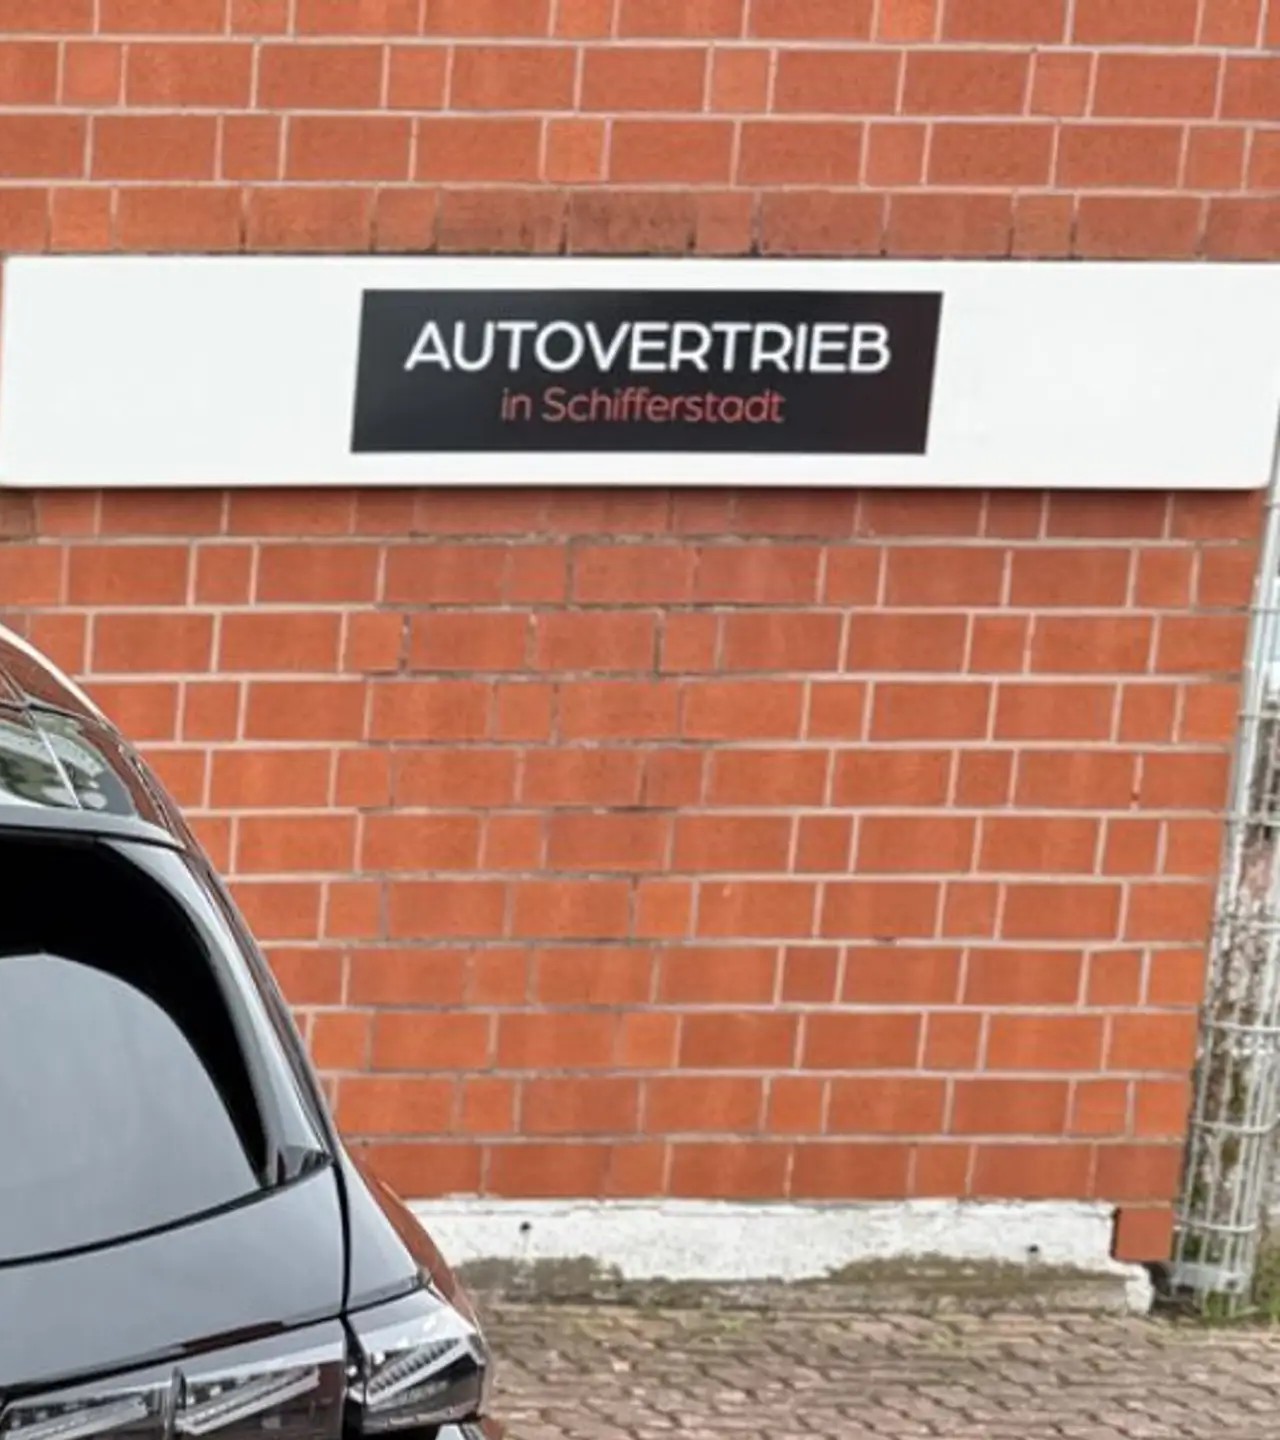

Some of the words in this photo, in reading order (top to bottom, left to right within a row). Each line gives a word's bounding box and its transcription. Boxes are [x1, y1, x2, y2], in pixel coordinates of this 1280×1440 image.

[402, 319, 892, 375] AUTOVERTRIEB
[500, 387, 532, 423] in
[541, 386, 785, 424] Schifferstadt
